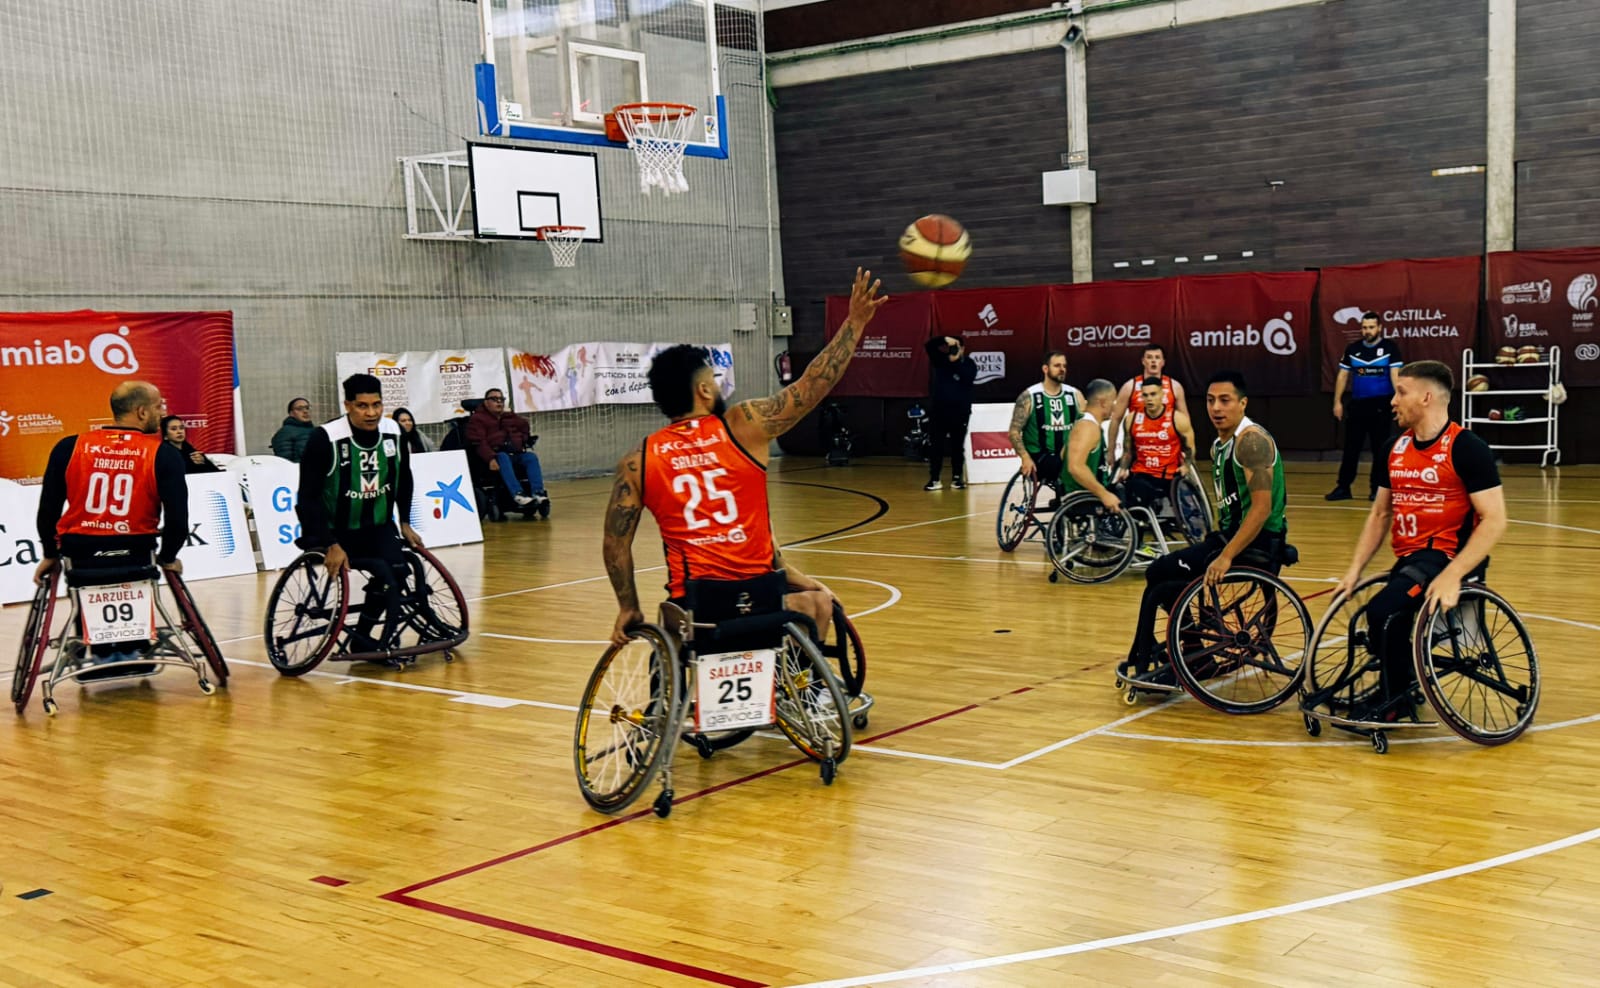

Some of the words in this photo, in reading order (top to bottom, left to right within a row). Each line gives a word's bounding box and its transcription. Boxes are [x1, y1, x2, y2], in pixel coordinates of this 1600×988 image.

[1383, 309, 1447, 321] CASTILLA-
[1067, 324, 1151, 346] gaviota
[1190, 325, 1261, 347] amiab
[1383, 327, 1400, 339] LA
[1402, 326, 1459, 339] MANCHA
[0, 339, 86, 367] miab
[1050, 399, 1063, 411] 90
[358, 450, 380, 471] 24
[981, 448, 1016, 457] UCLM
[85, 471, 134, 517] 09
[345, 483, 391, 500] JOVENTUT
[672, 467, 739, 530] 25
[88, 590, 145, 604] ZARZUELA
[102, 603, 134, 623] 09
[709, 661, 763, 680] SALAZAR
[718, 677, 753, 704] 25
